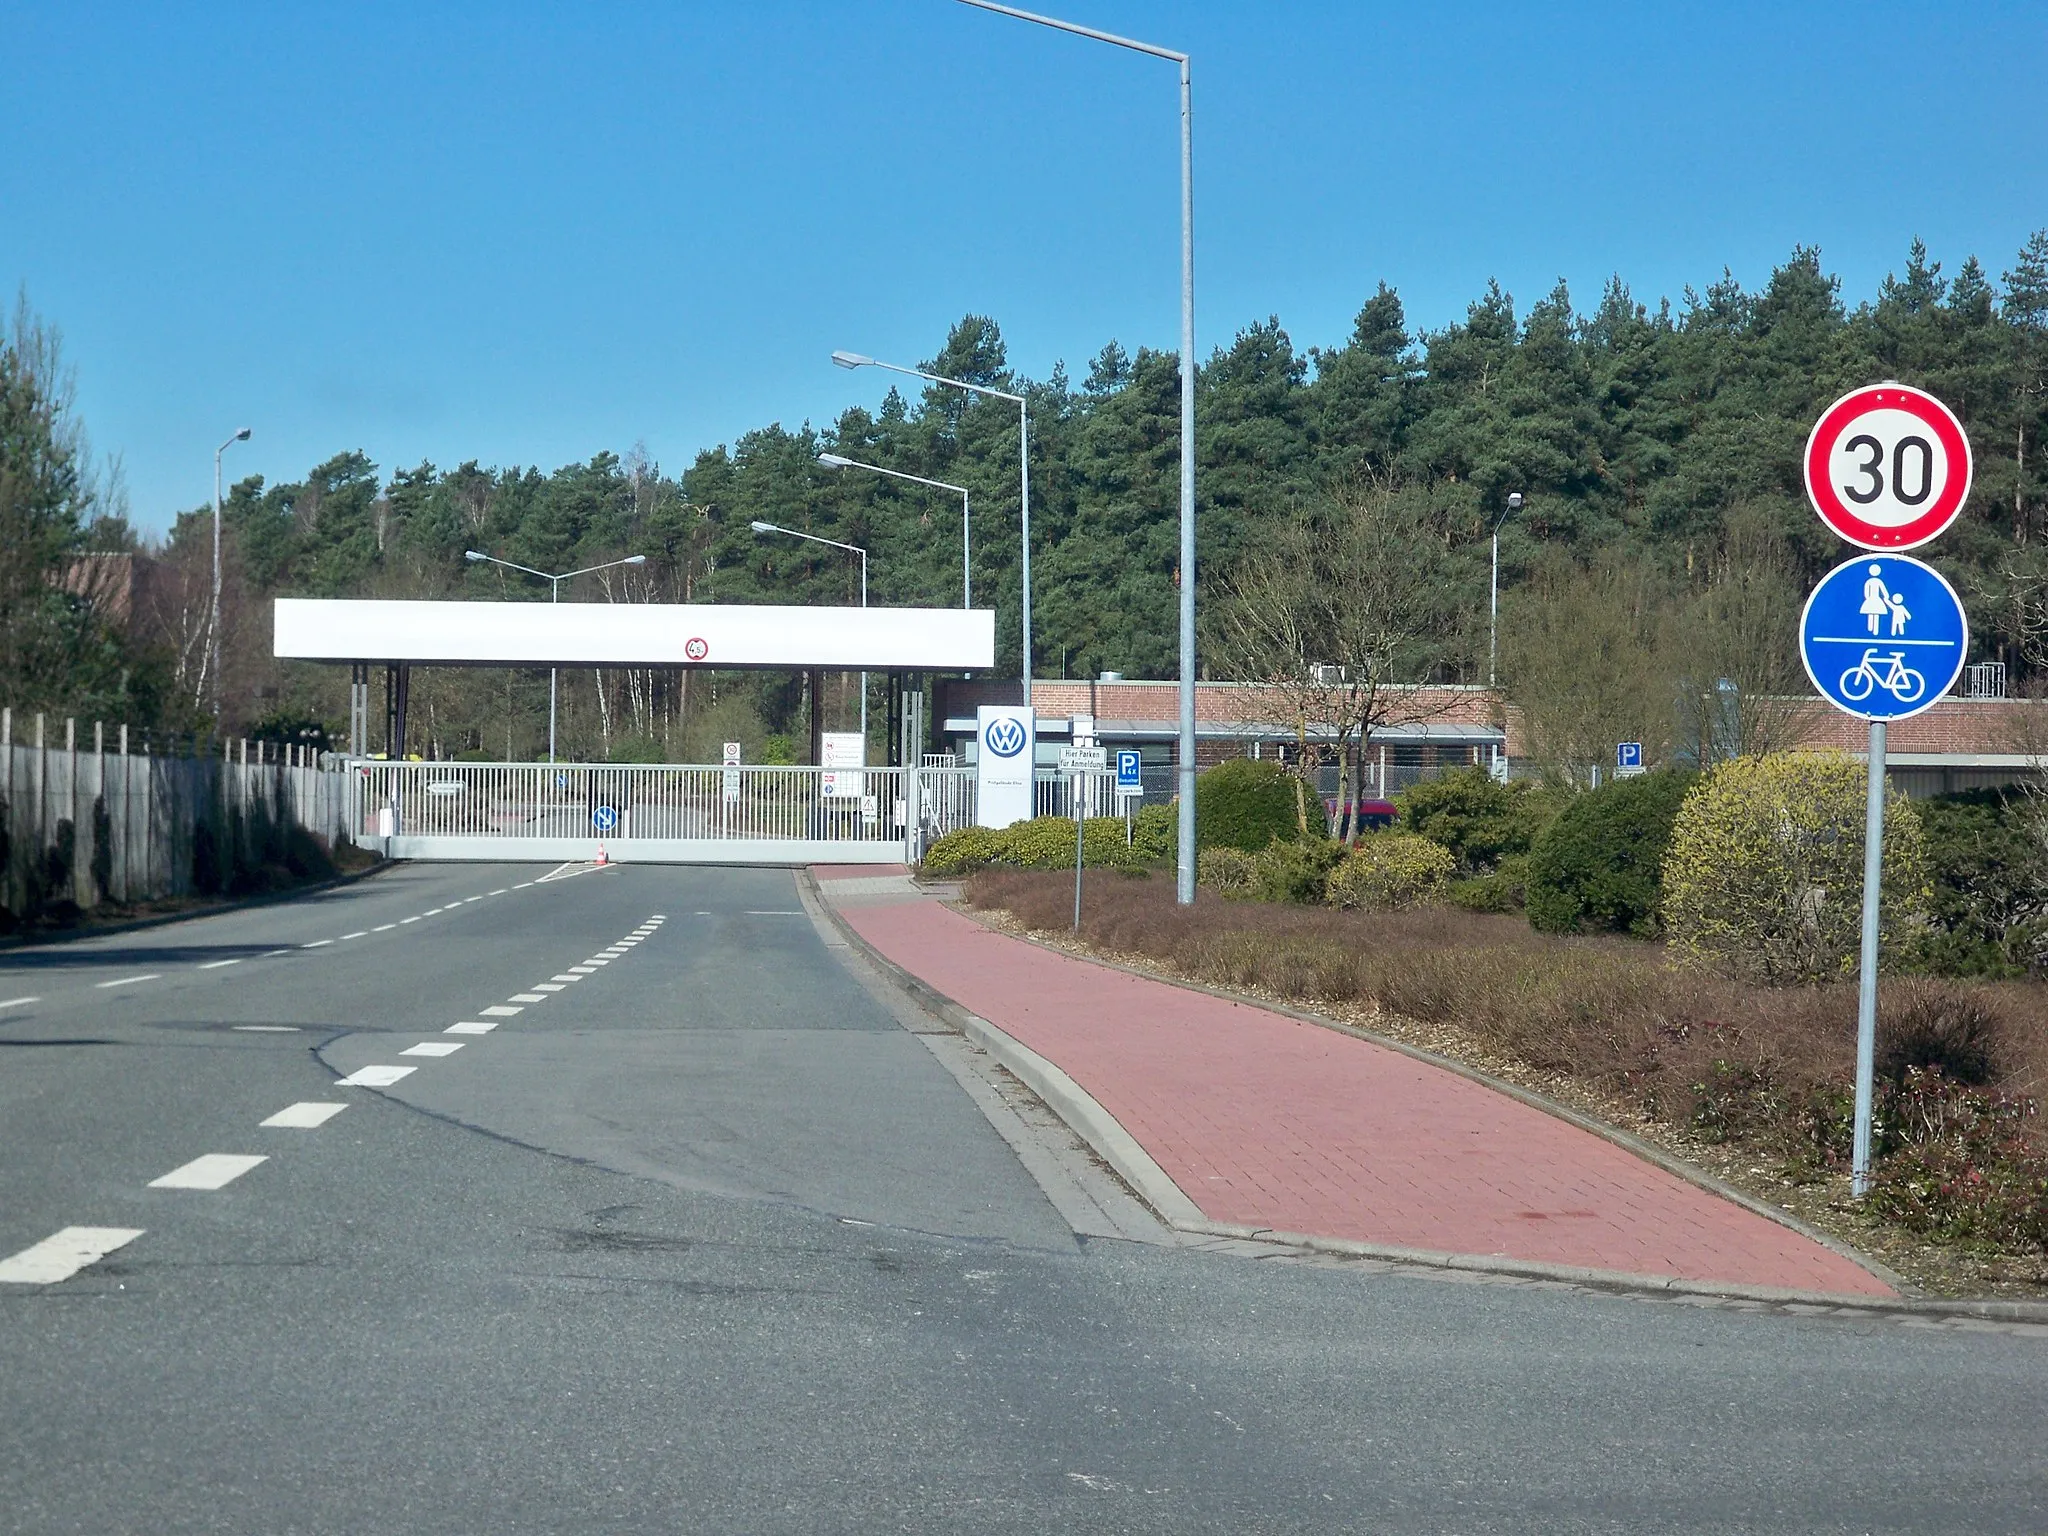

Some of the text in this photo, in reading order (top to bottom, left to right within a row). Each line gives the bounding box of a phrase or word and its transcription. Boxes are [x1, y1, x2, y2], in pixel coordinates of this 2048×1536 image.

[1843, 434, 1933, 506] 30
[1065, 749, 1100, 759] Hier Parken
[1623, 746, 1636, 765] P
[1071, 760, 1104, 770] Anmeldung
[1121, 754, 1136, 775] P
